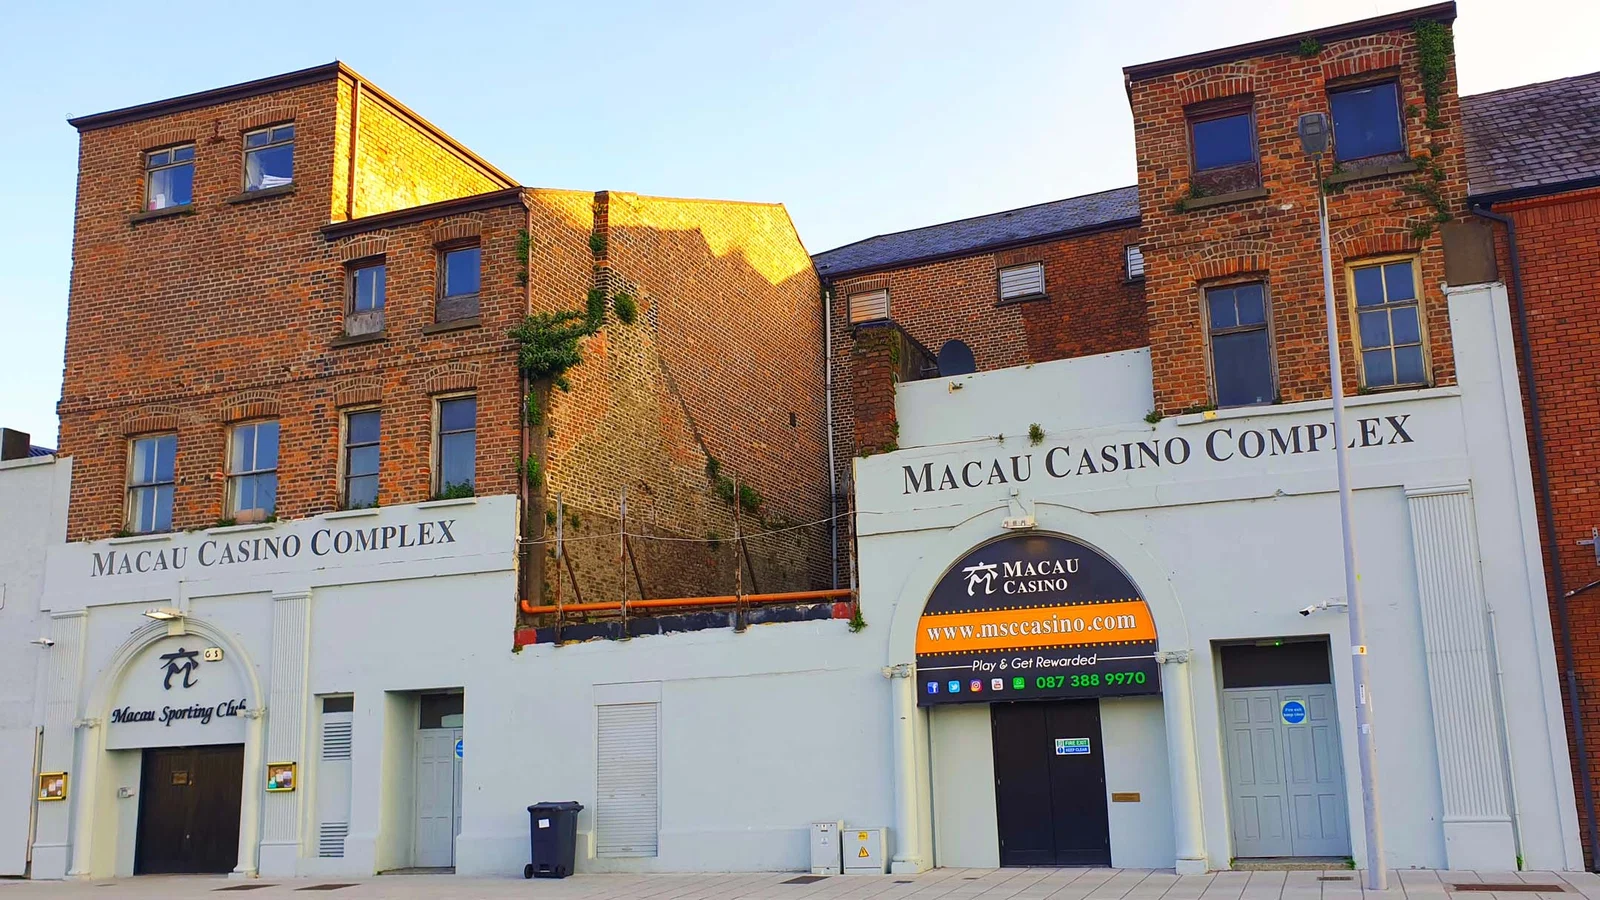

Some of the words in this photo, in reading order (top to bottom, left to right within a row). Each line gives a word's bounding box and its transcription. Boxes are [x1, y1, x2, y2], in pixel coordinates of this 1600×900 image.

[902, 455, 1032, 495] MACAU
[1045, 437, 1191, 478] CASINO
[91, 546, 188, 577] MACAU
[197, 534, 301, 567] CASINO
[310, 519, 456, 556] COMPLEX
[1002, 558, 1080, 578] MACAU
[1003, 578, 1068, 595] CASINO
[927, 614, 1136, 642] www.msccasino.com
[972, 659, 997, 673] Play
[999, 658, 1008, 670] &
[1011, 657, 1034, 669] Get
[1036, 654, 1097, 668] Rewarded
[1036, 675, 1065, 689] 087
[1070, 673, 1100, 687] 388
[1105, 671, 1146, 685] 9970
[111, 706, 156, 724] Macau
[158, 703, 214, 726] Sporting
[216, 698, 247, 717] Club
